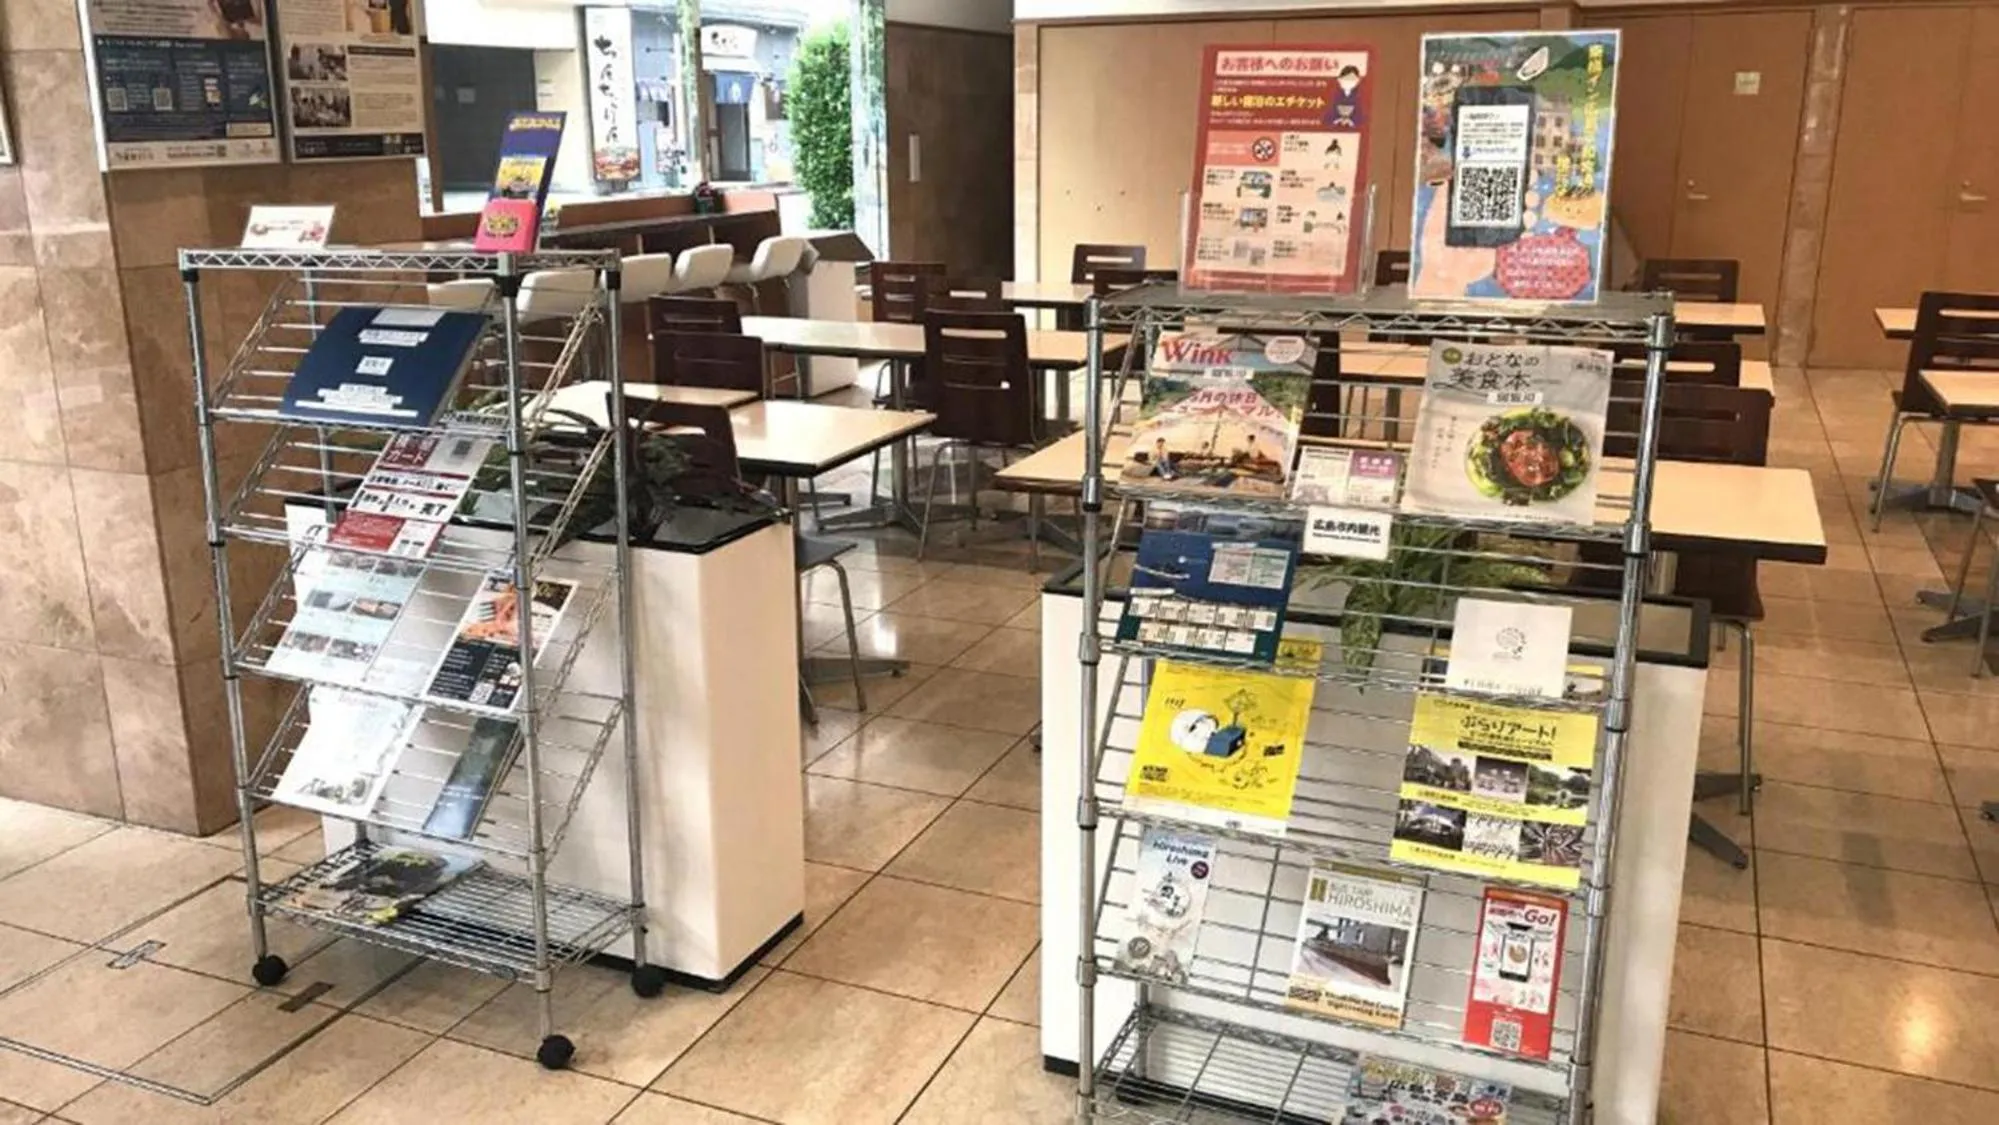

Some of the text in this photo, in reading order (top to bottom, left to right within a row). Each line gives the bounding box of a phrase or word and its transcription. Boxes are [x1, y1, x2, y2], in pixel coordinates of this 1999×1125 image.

[1221, 57, 1338, 71] お客様へのお願い
[1160, 338, 1232, 364] Wink
[1465, 352, 1540, 368] おとなの
[1450, 368, 1531, 390] 美食本
[1313, 519, 1381, 537] 広島市内観光
[1461, 715, 1558, 741] ぷらりアート!
[1153, 839, 1210, 858] Hiroshima
[1166, 854, 1189, 866] Live
[1327, 892, 1413, 918] HIROSHIMA
[1524, 909, 1557, 927] Go!
